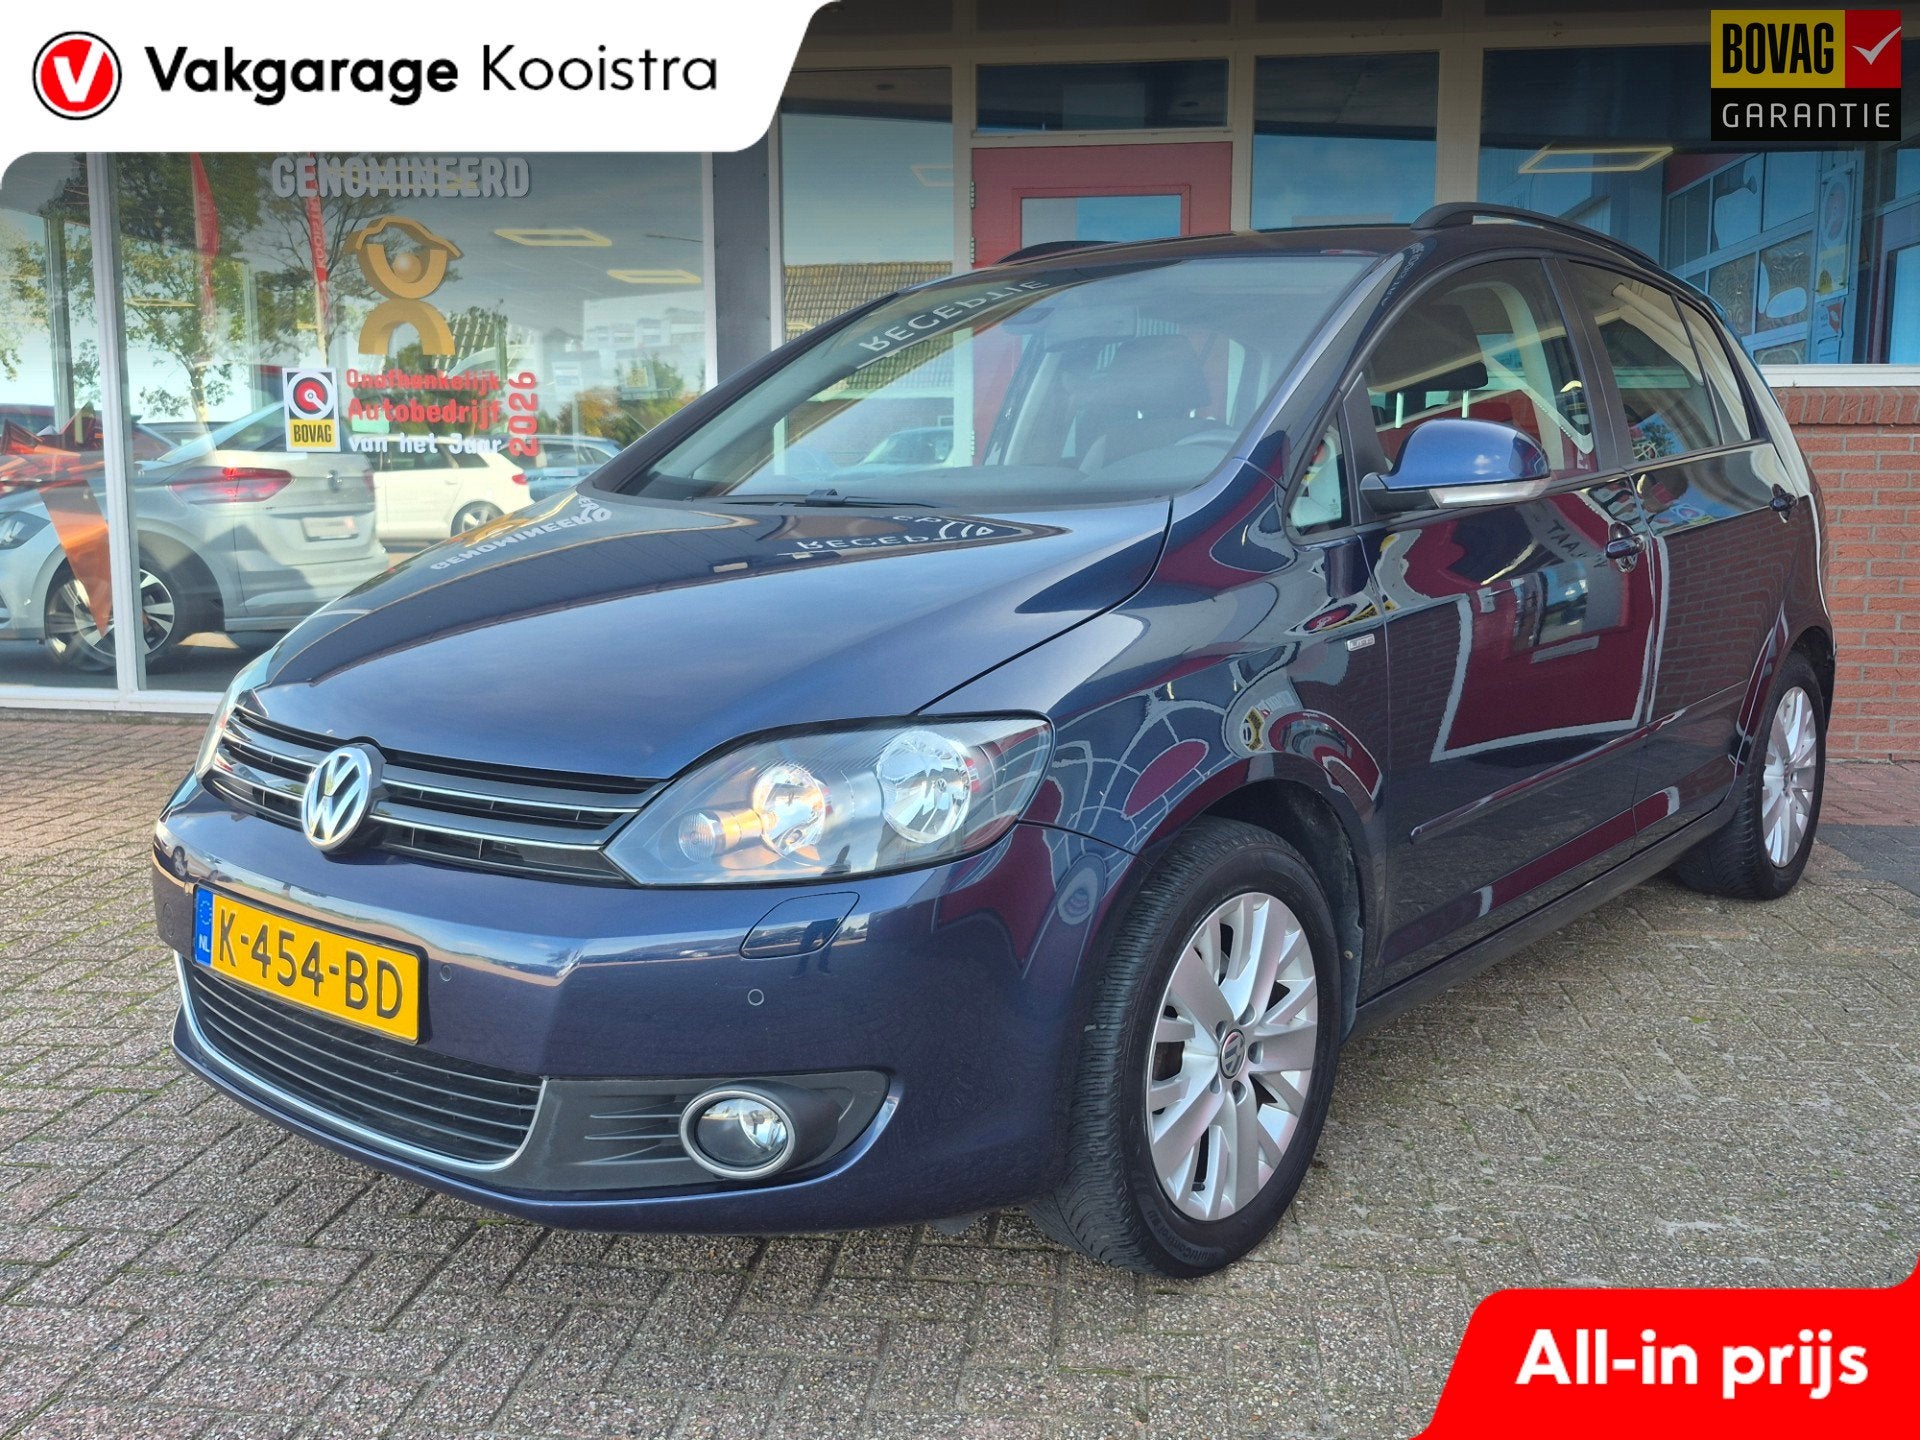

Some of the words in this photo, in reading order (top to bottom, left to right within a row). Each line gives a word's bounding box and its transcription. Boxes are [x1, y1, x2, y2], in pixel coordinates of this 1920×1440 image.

[271, 156, 530, 198] GENOMINEERD
[345, 368, 499, 396] Onafhankelijk
[348, 397, 502, 431] Autobedrijf
[508, 371, 539, 458] 2026
[293, 424, 332, 443] BOVAG
[349, 435, 388, 454] van
[400, 432, 438, 454] het
[451, 433, 503, 455] Jaar
[198, 933, 210, 953] NL
[219, 908, 403, 1020] K-454-BD
